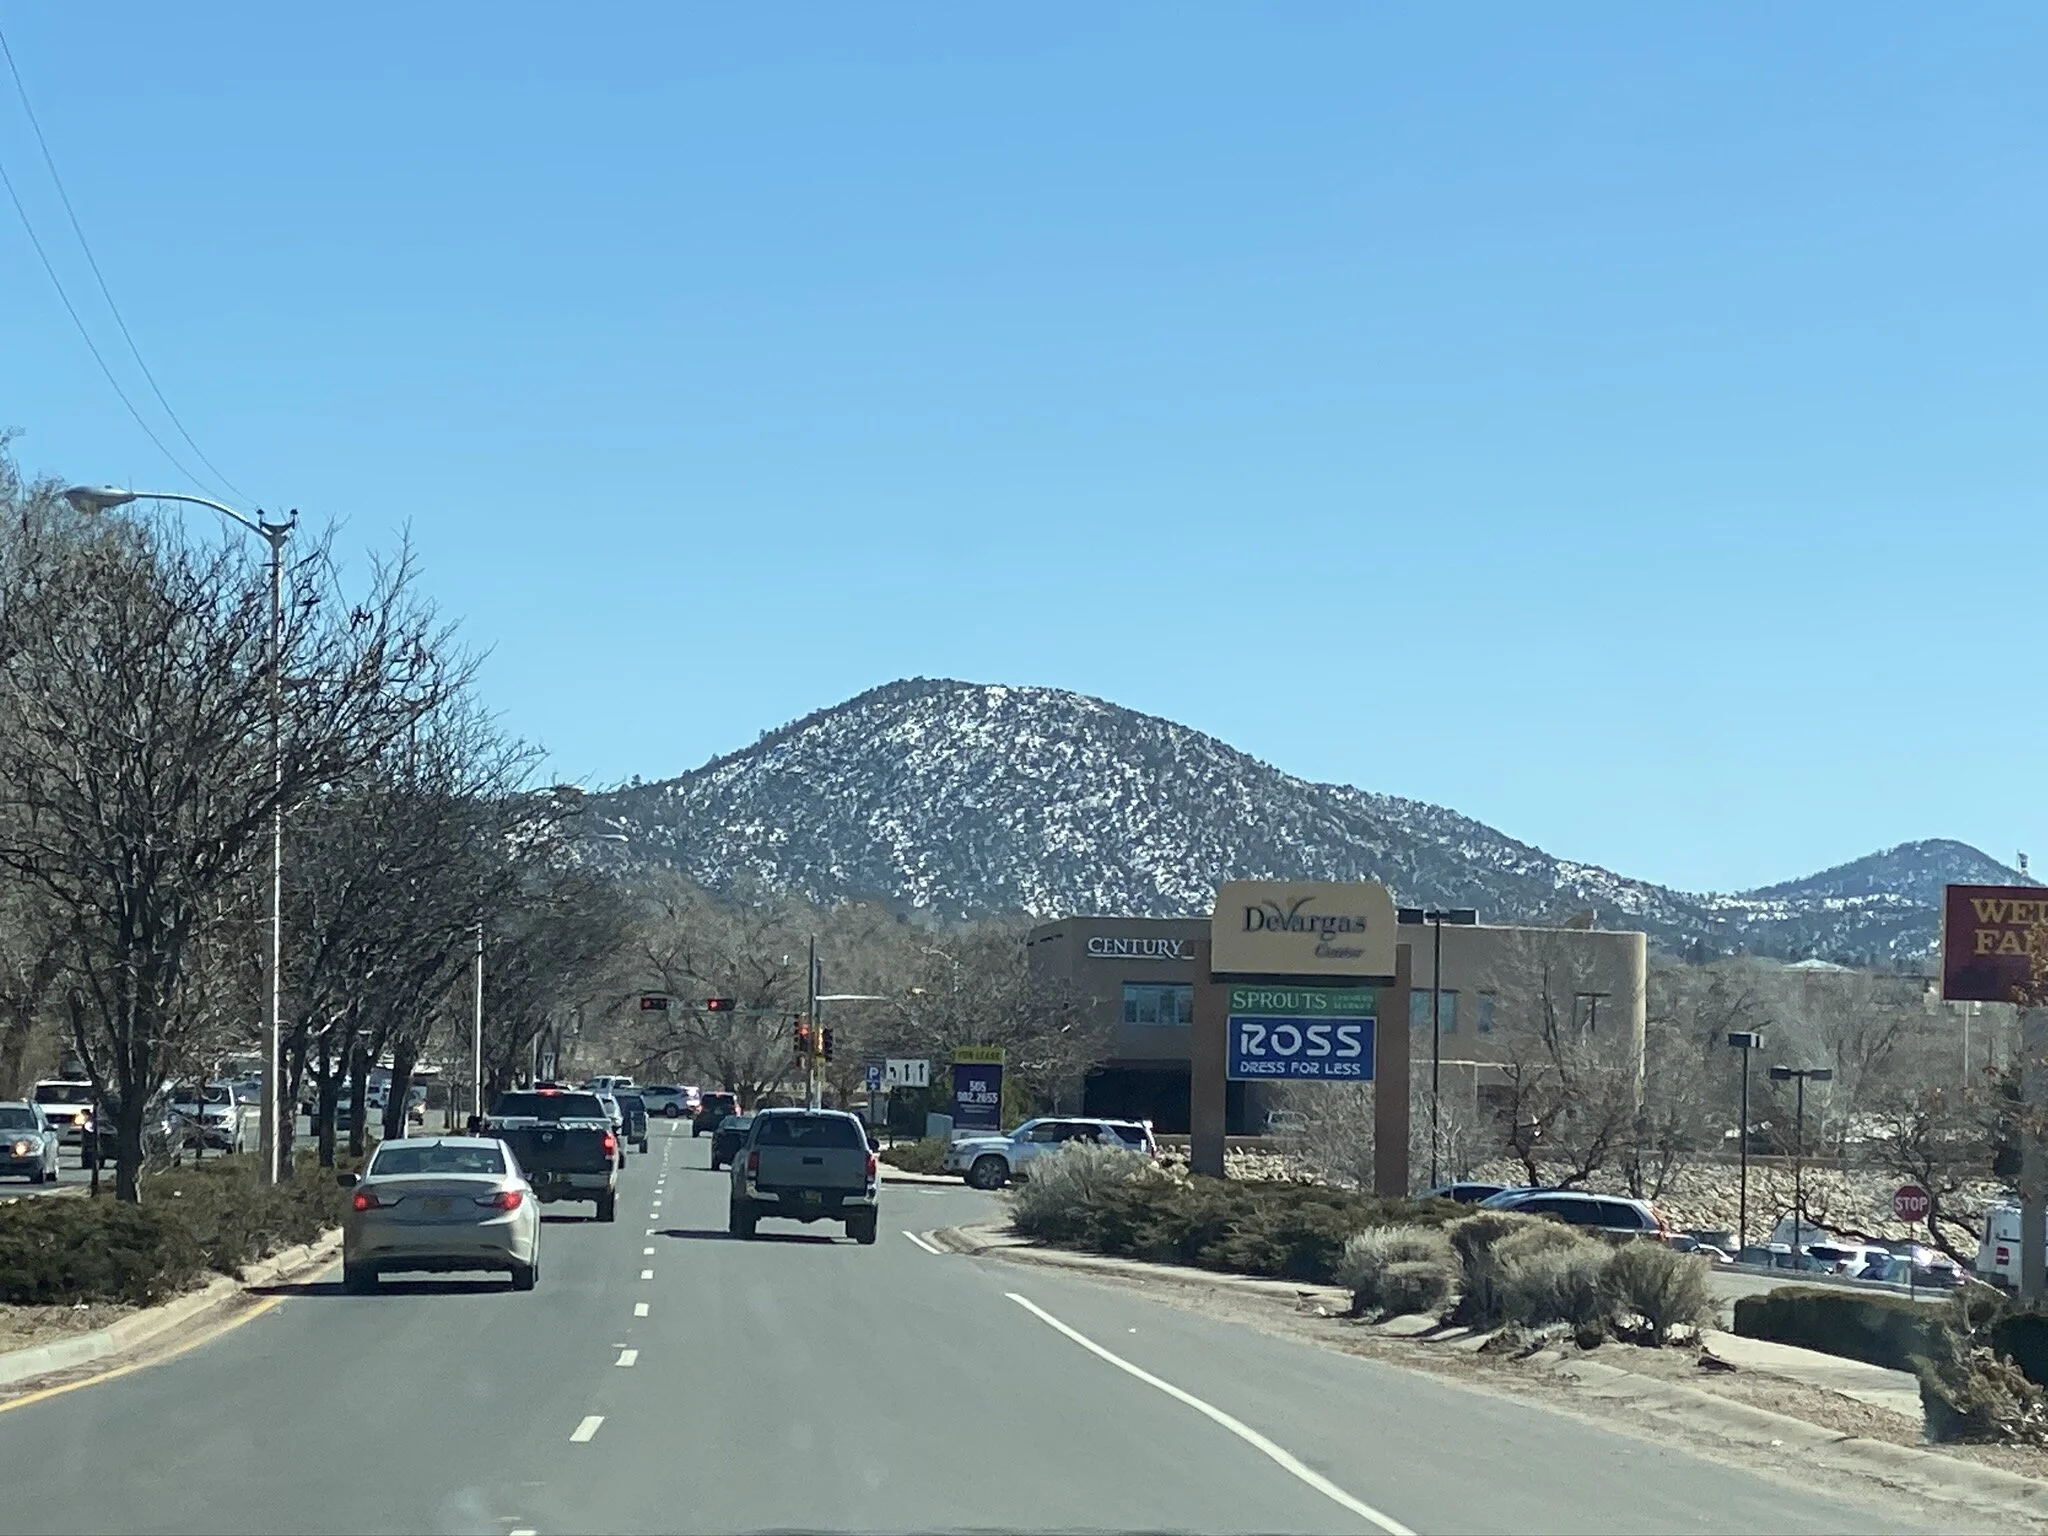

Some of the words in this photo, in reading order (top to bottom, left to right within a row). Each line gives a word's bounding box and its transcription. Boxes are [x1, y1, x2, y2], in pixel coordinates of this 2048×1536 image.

[1243, 896, 1367, 941] DeVargas
[1087, 936, 1184, 959] CENTURY
[1232, 991, 1328, 1010] SPROUTS
[1240, 1023, 1362, 1058] ROSS
[1240, 1061, 1286, 1074] DRESS
[1290, 1062, 1320, 1074] FOR
[1324, 1063, 1361, 1076] LESS
[1894, 1196, 1928, 1213] STOP
